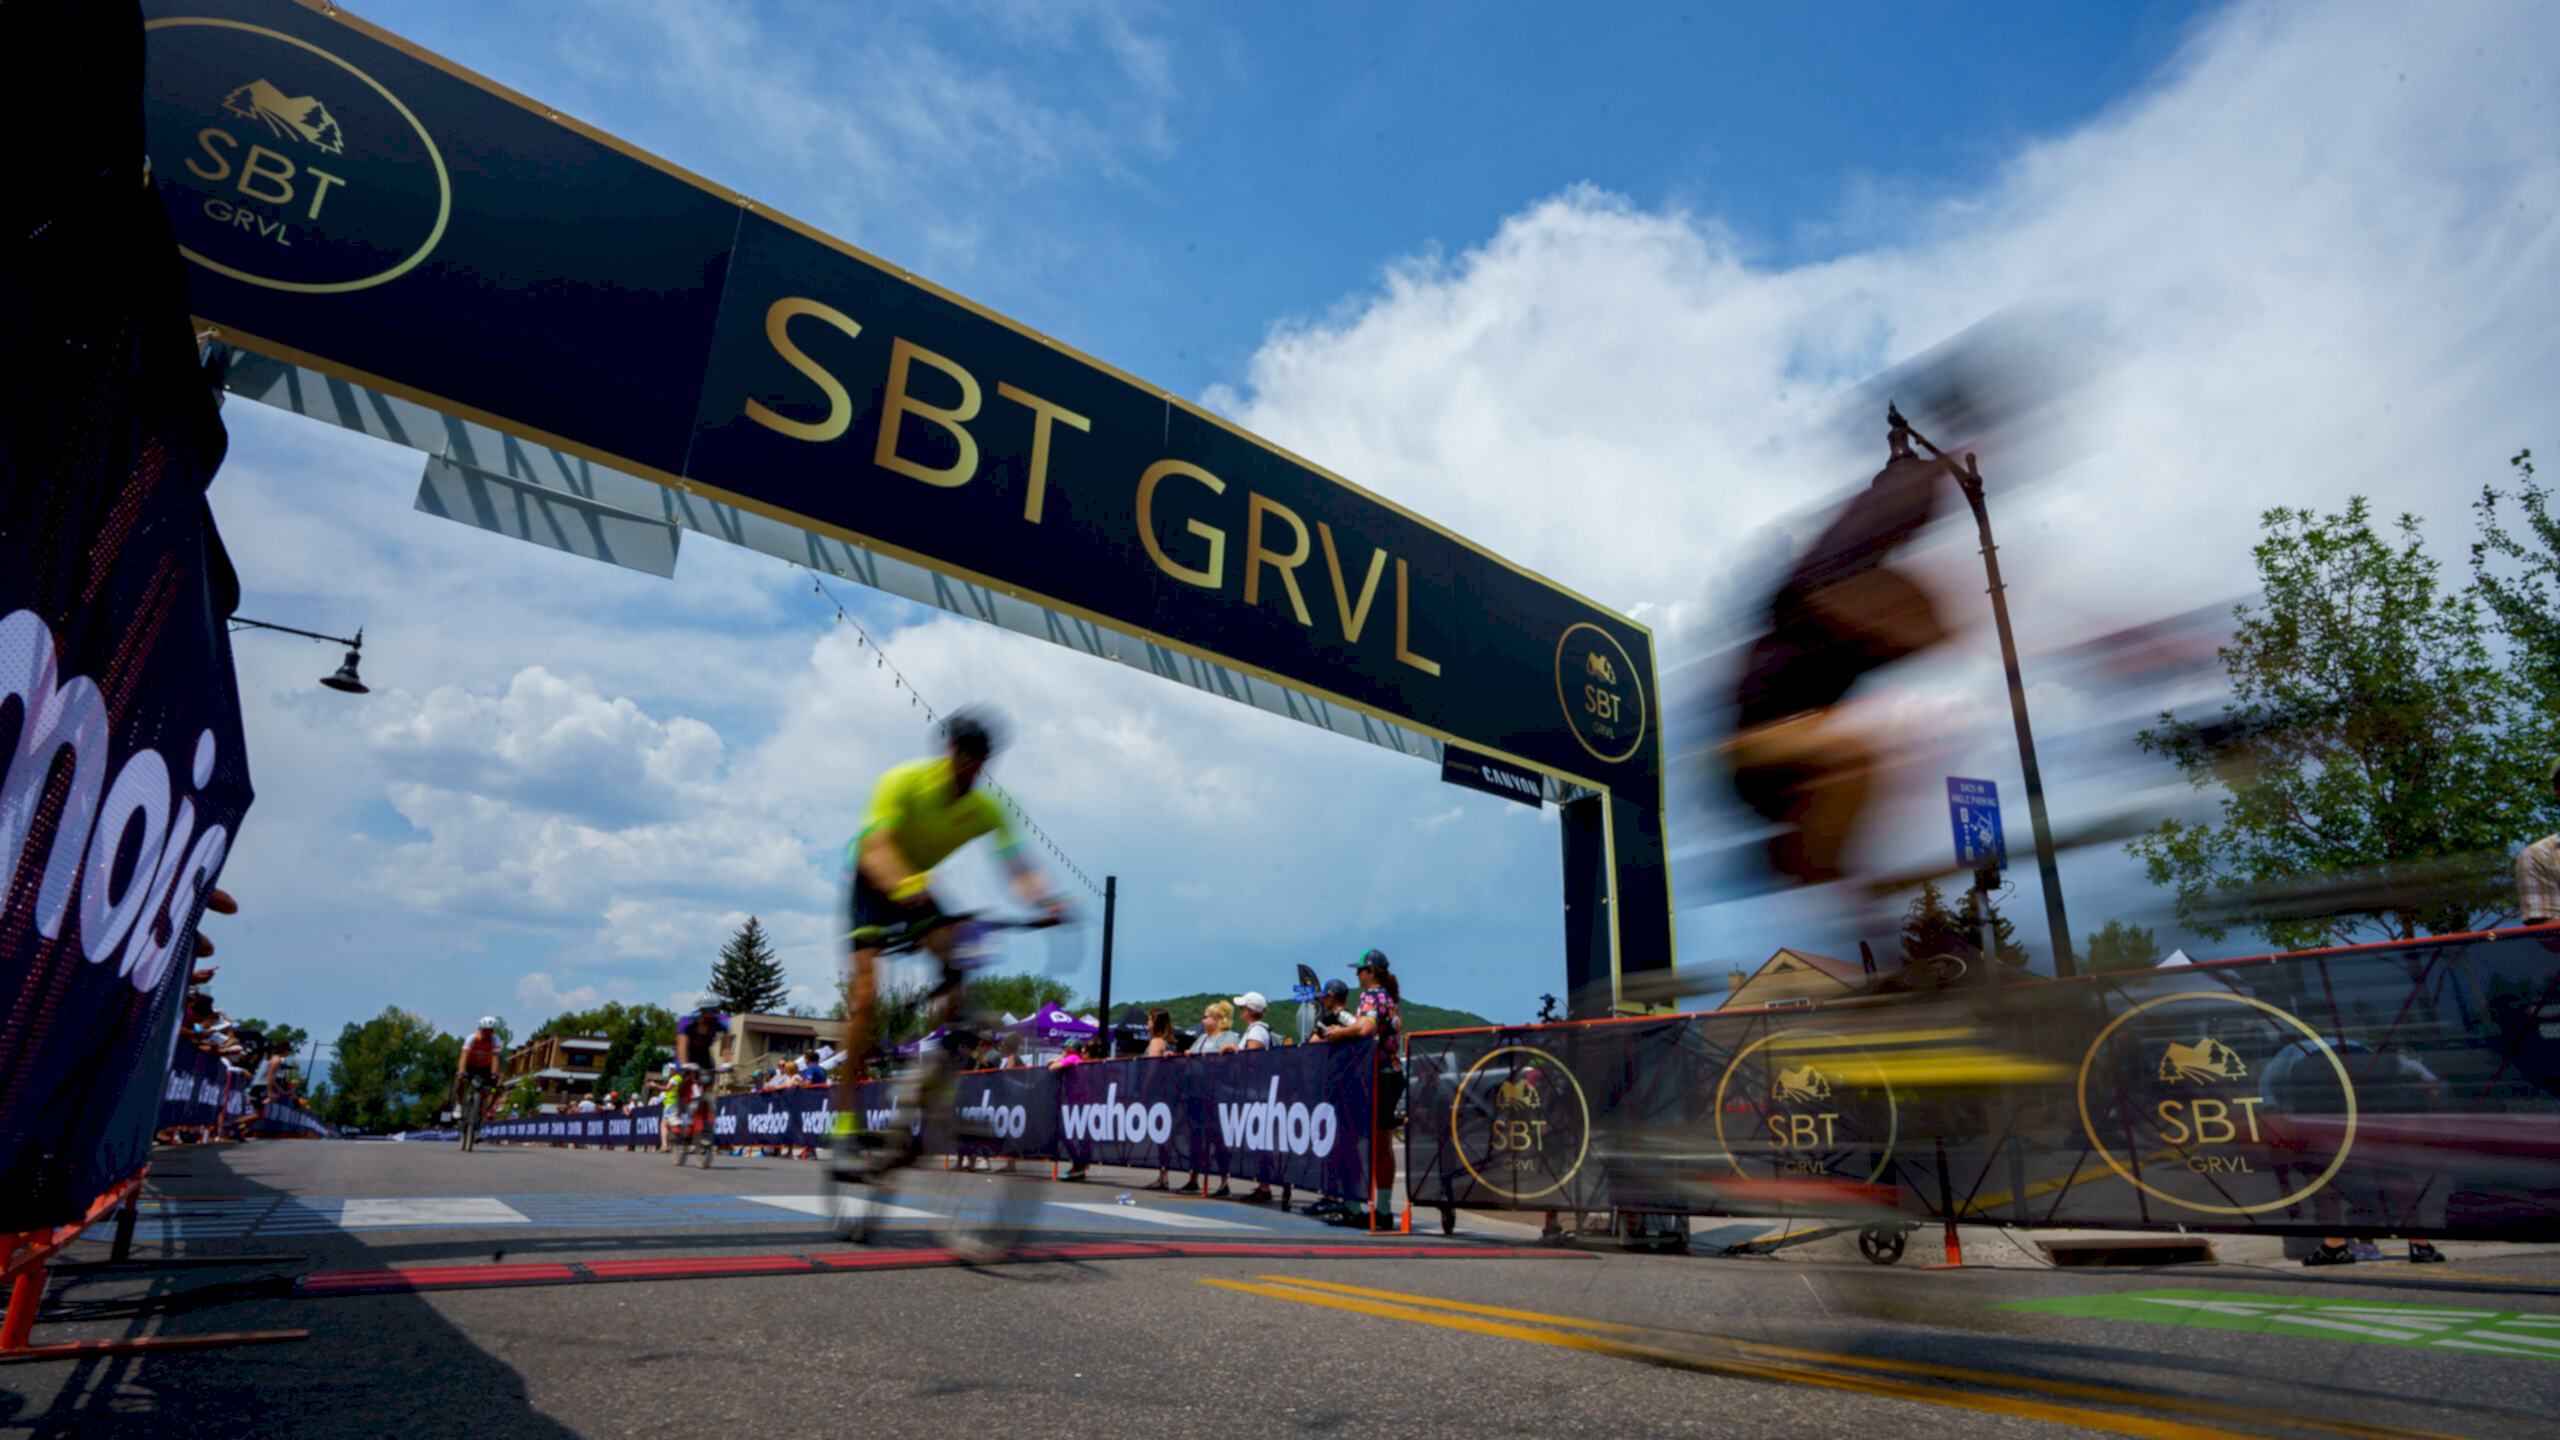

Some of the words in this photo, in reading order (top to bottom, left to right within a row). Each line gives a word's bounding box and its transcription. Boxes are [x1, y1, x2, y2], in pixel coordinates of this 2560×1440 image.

[184, 128, 346, 220] SBT
[204, 199, 291, 246] GRVL
[746, 296, 1091, 525] SBT
[1135, 458, 1441, 677] GRVL
[1585, 684, 1621, 723] SBT
[1481, 765, 1541, 797] CANYON
[747, 1102, 790, 1134] wahoo
[1061, 1082, 1173, 1144] wahoo
[1218, 1075, 1337, 1158] wahoo
[1767, 1113, 1839, 1150] SBT
[2157, 1097, 2264, 1144] SBT
[1491, 1120, 1547, 1151] SBT
[1784, 1160, 1828, 1175] GRVL
[2187, 1155, 2254, 1174] GRVL
